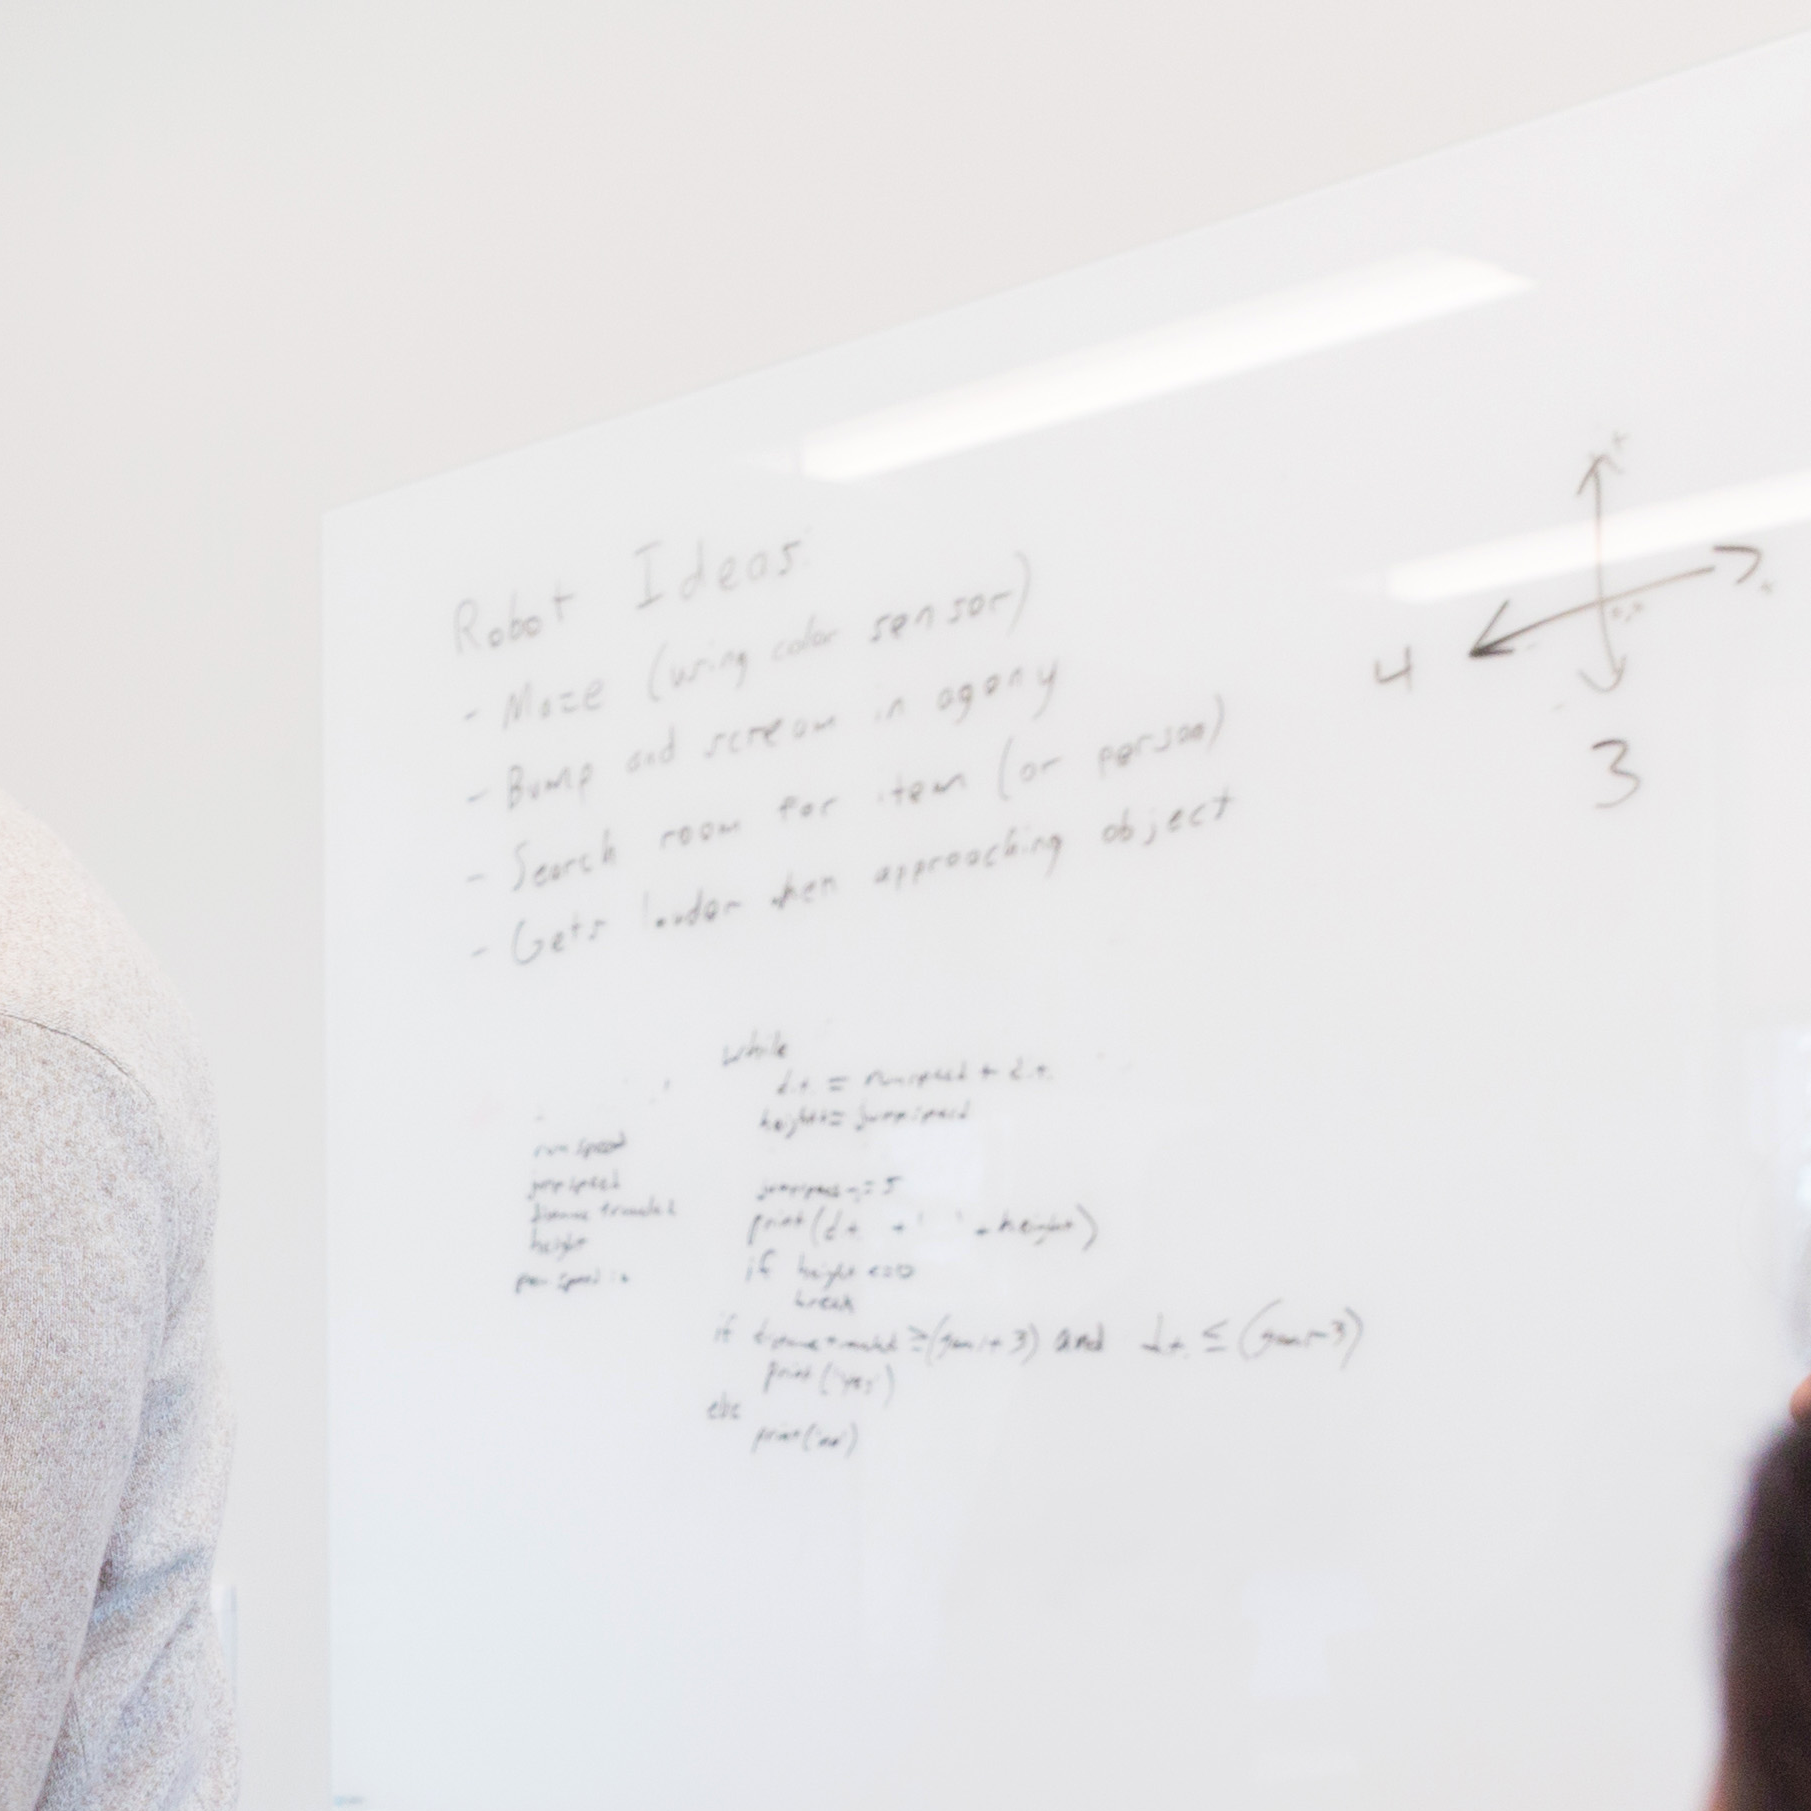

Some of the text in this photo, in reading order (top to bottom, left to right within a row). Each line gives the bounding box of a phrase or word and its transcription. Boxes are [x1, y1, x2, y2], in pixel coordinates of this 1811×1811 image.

[452, 579, 577, 654] Robot
[501, 678, 605, 731] Maze
[647, 640, 749, 703] (using
[771, 612, 841, 664] color
[869, 550, 1033, 643] sensor)
[1374, 643, 1413, 692] 4
[508, 762, 593, 811] Bump
[626, 724, 676, 774] and
[874, 690, 905, 722] in
[936, 659, 1059, 725] agony
[1591, 737, 1642, 810] 3
[511, 827, 616, 892] Search
[659, 818, 741, 850] room
[777, 794, 839, 823] for
[876, 769, 967, 806] item
[997, 734, 1063, 801] (or
[511, 912, 607, 966] Gets
[874, 825, 1065, 891] approaching
[1101, 784, 1235, 848] object
[1054, 1320, 1105, 1354] and
